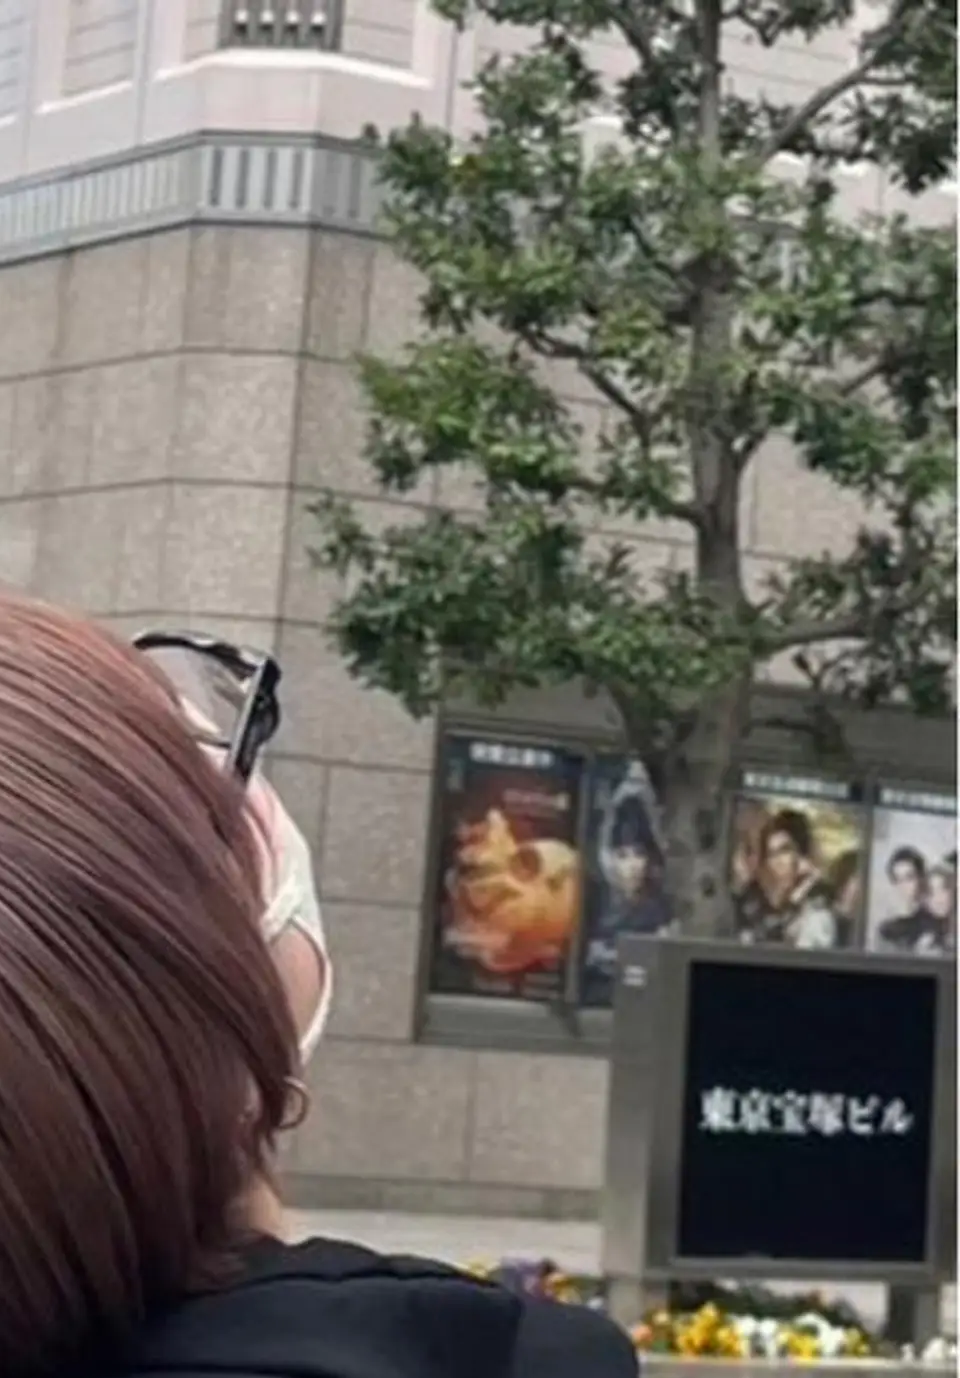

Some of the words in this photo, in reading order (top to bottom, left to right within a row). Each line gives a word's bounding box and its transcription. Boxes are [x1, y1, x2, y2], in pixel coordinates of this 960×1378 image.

[699, 1086, 913, 1135] 東京宝塚ビル
